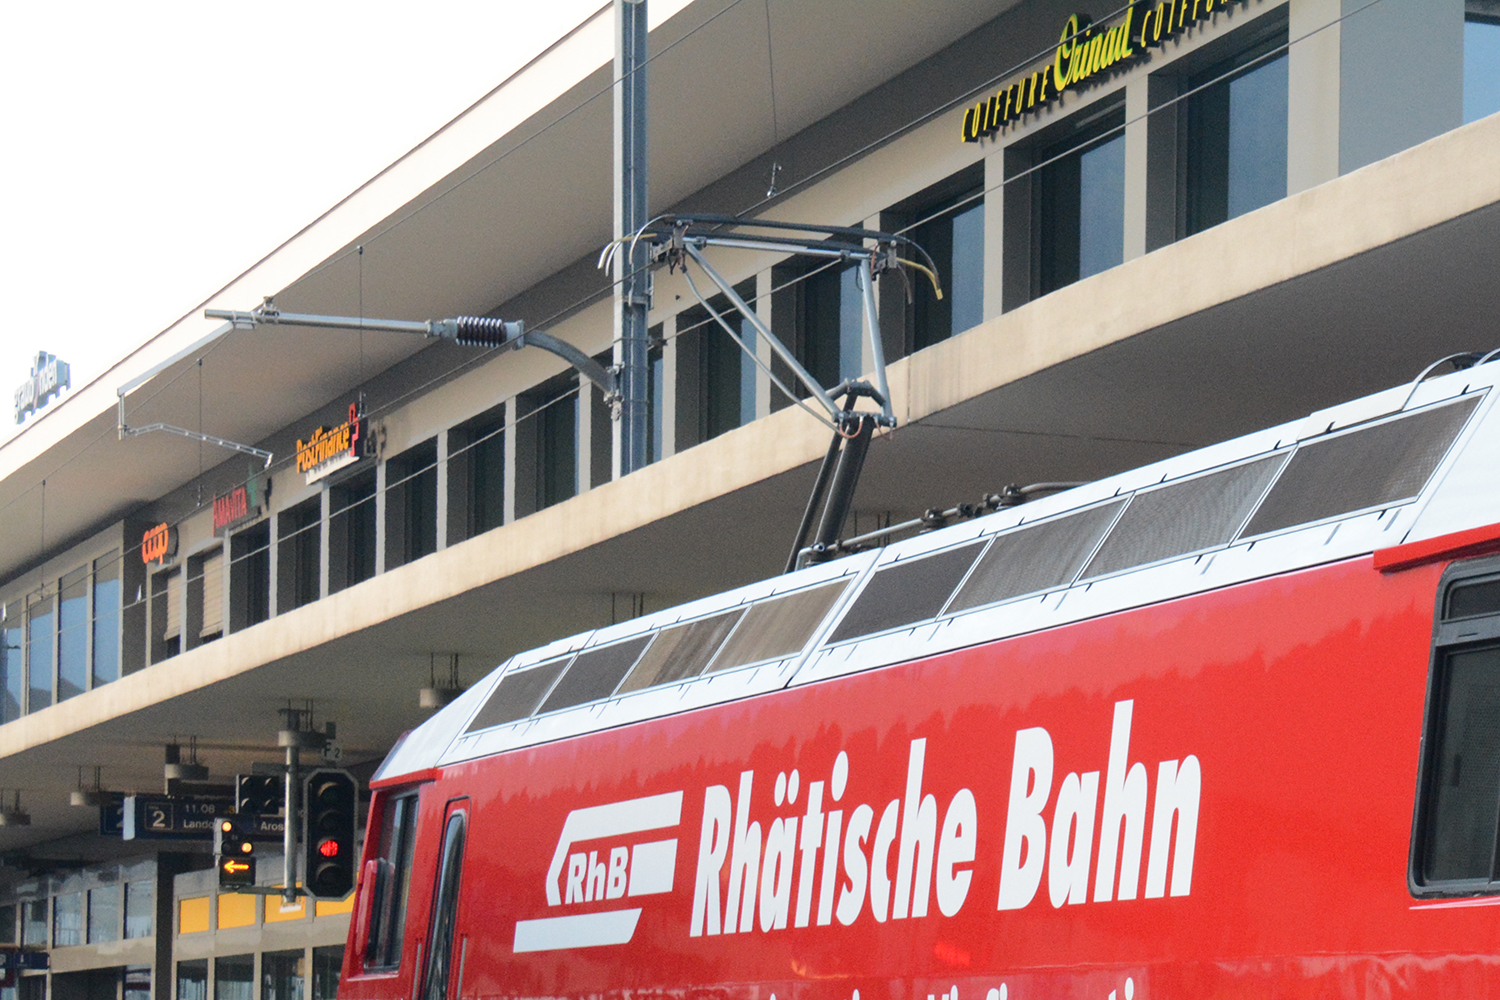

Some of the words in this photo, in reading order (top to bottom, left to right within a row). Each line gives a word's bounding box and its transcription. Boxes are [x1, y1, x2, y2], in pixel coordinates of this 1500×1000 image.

[961, 65, 1050, 142] COIFFURE
[142, 522, 169, 565] coop
[260, 820, 285, 831] Aros
[690, 738, 977, 937] Rhätische
[998, 699, 1201, 911] Bahn
[565, 846, 629, 905] RhB
